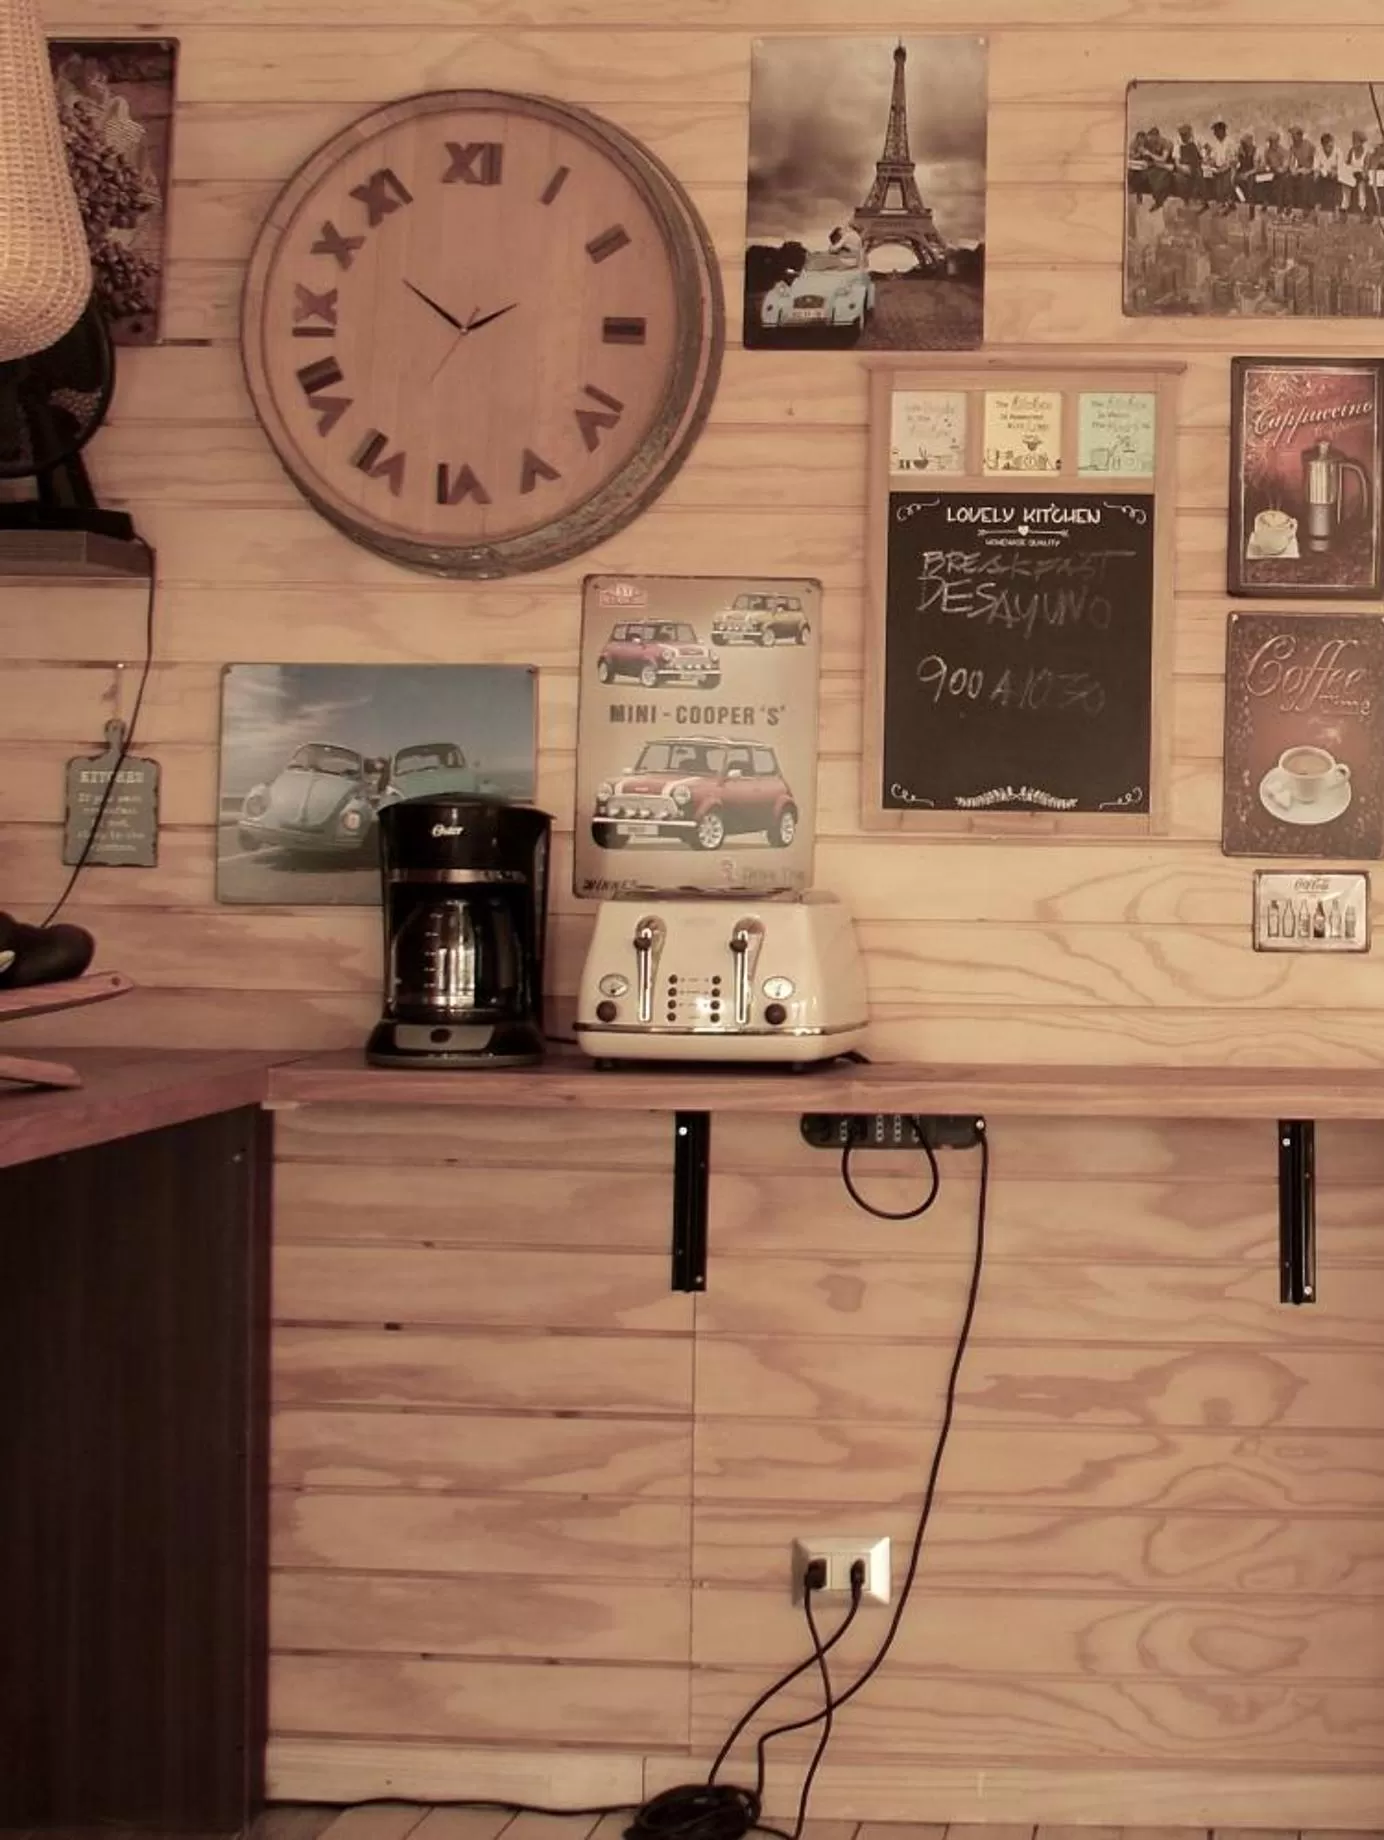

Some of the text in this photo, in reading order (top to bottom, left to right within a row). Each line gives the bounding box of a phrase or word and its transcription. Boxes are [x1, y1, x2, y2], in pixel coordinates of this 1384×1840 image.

[1253, 401, 1373, 448] Cappuccino
[946, 502, 1101, 524] LOVELY KITCHEN
[916, 576, 1112, 640] DESAYUNO
[1245, 634, 1367, 711] Coffee
[608, 704, 657, 724] MINI
[675, 705, 755, 725] COOPER
